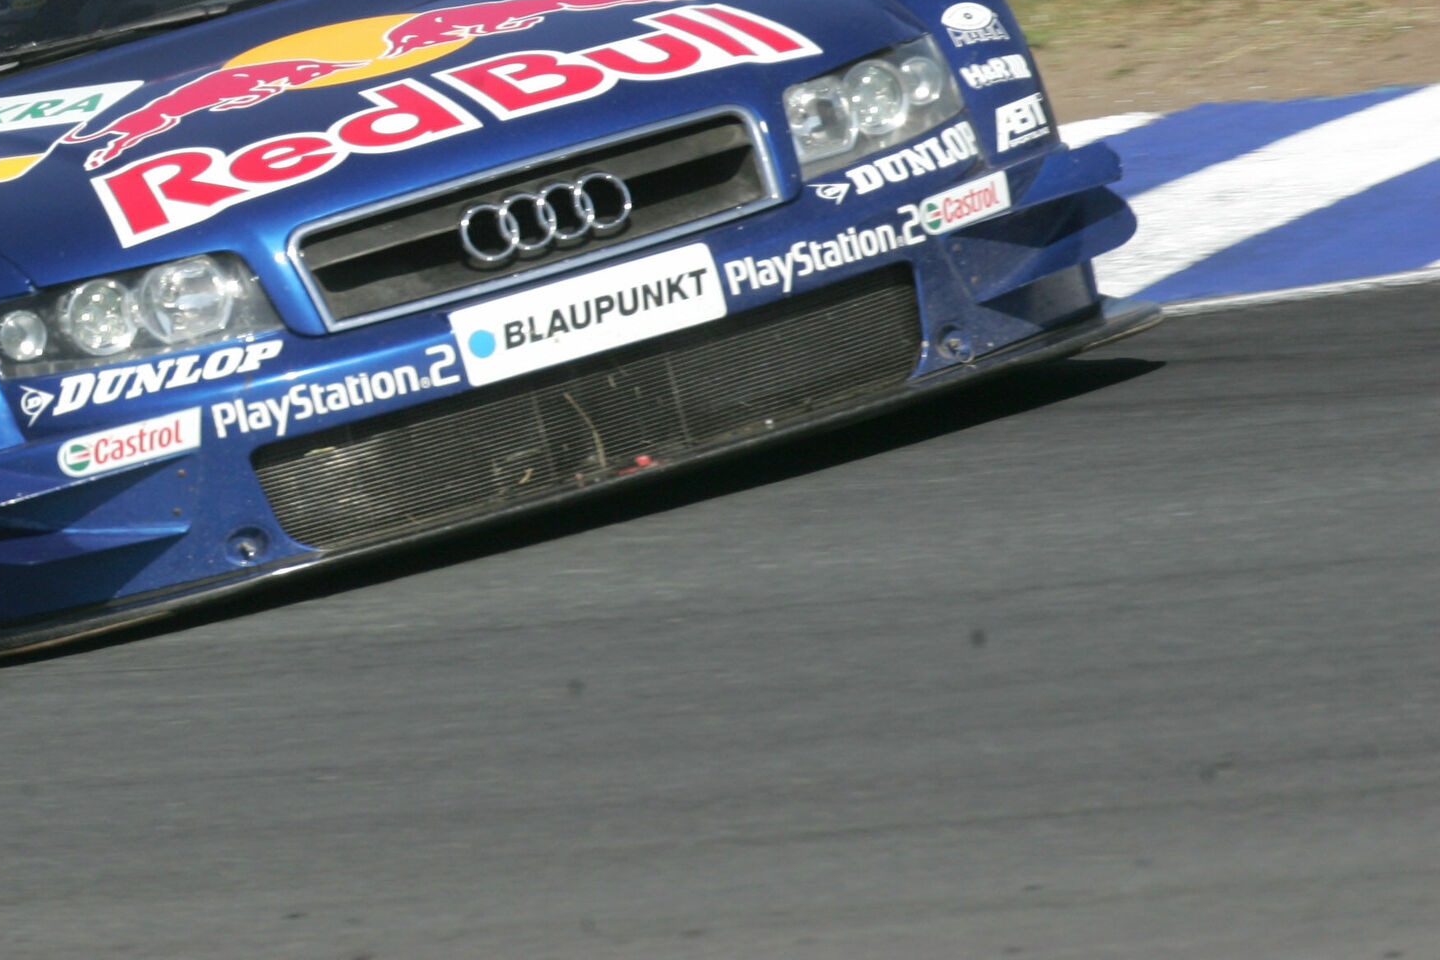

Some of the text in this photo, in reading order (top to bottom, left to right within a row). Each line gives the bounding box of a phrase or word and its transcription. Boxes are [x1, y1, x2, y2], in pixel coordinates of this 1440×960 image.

[90, 2, 825, 249] Red Bull
[845, 120, 979, 195] DUNLOP
[995, 92, 1047, 153] ABT
[942, 180, 1000, 223] Castrol
[503, 267, 709, 351] BLAUPUNKT
[52, 340, 284, 417] DUNLOP
[94, 421, 184, 466] Castrol
